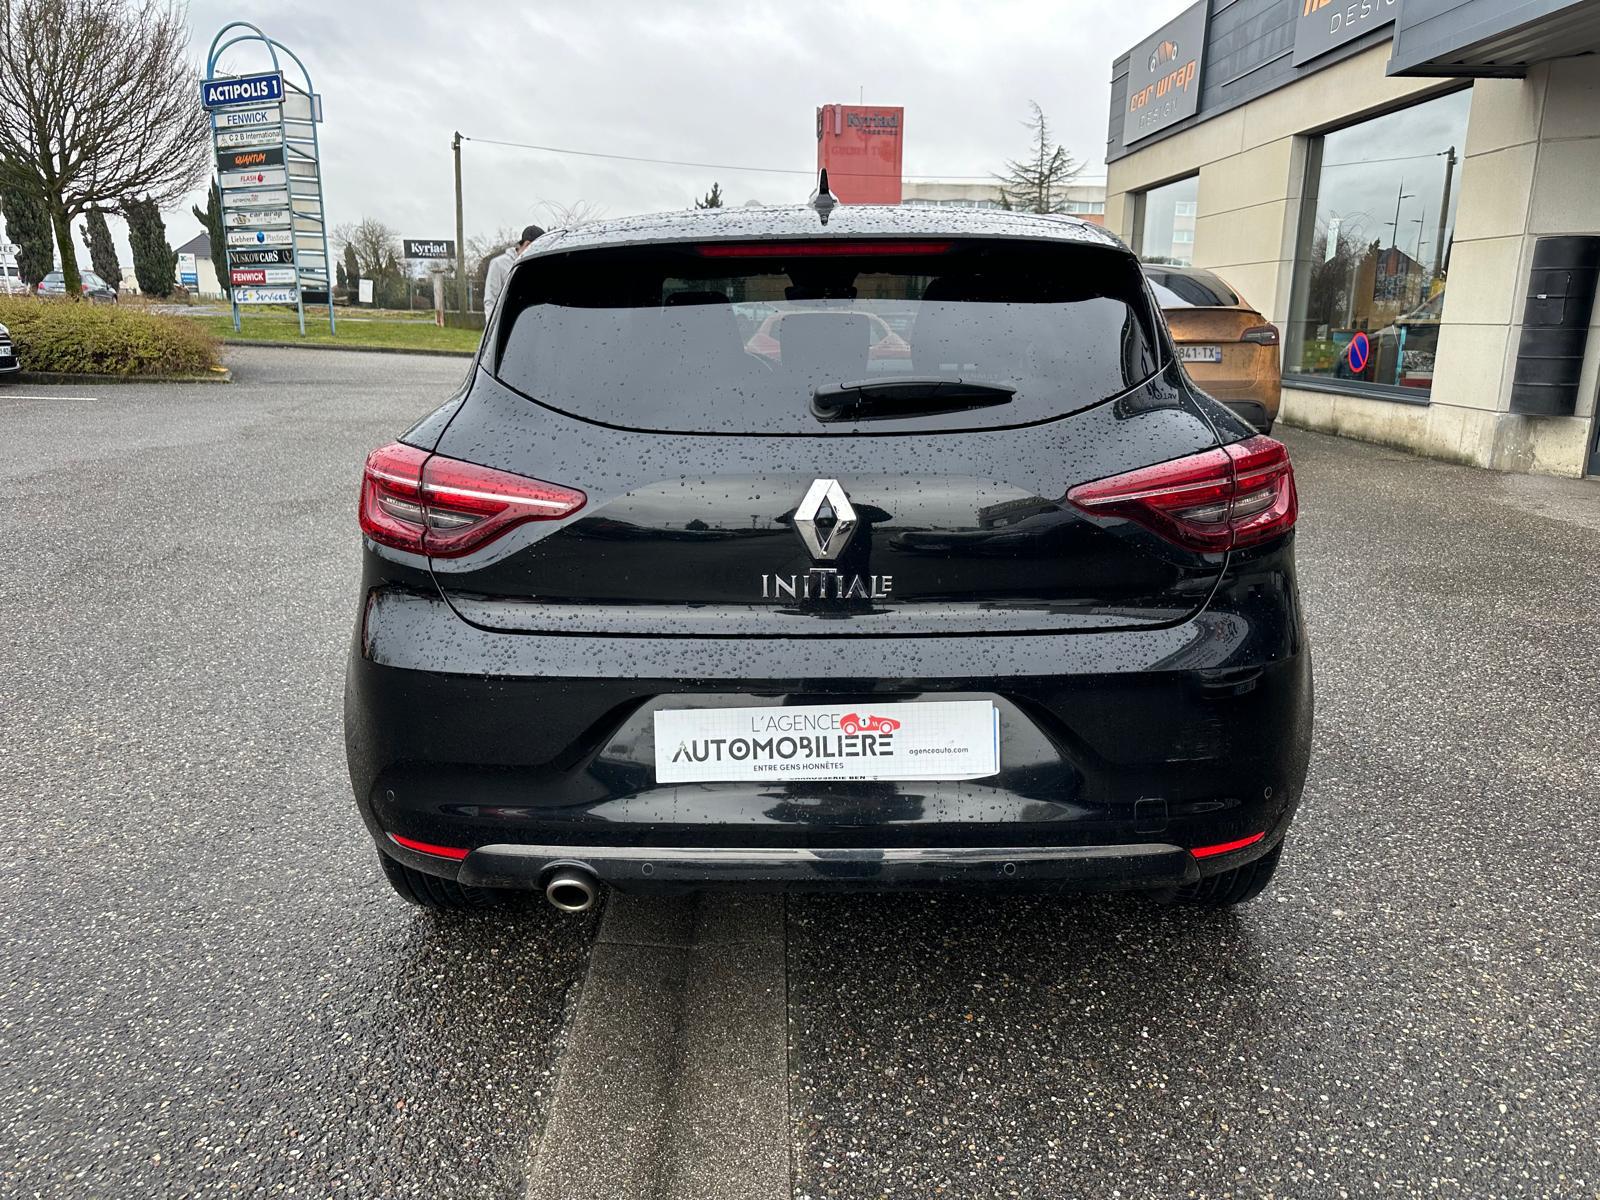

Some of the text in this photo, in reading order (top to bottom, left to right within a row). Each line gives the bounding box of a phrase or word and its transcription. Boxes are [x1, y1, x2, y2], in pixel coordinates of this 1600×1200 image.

[208, 80, 279, 101] ACTIPOLIS 1
[1130, 60, 1197, 112] car wrap
[227, 112, 268, 125] FENWICK
[235, 153, 266, 165] QUANTUM
[411, 242, 447, 256] Kyriad
[233, 272, 264, 282] FENWICK
[760, 567, 893, 599] INITIALE
[751, 714, 841, 733] L'AGENCE
[908, 746, 969, 756] agenceauto.com
[753, 761, 844, 772] ENTRE GENS HONNÊTES
